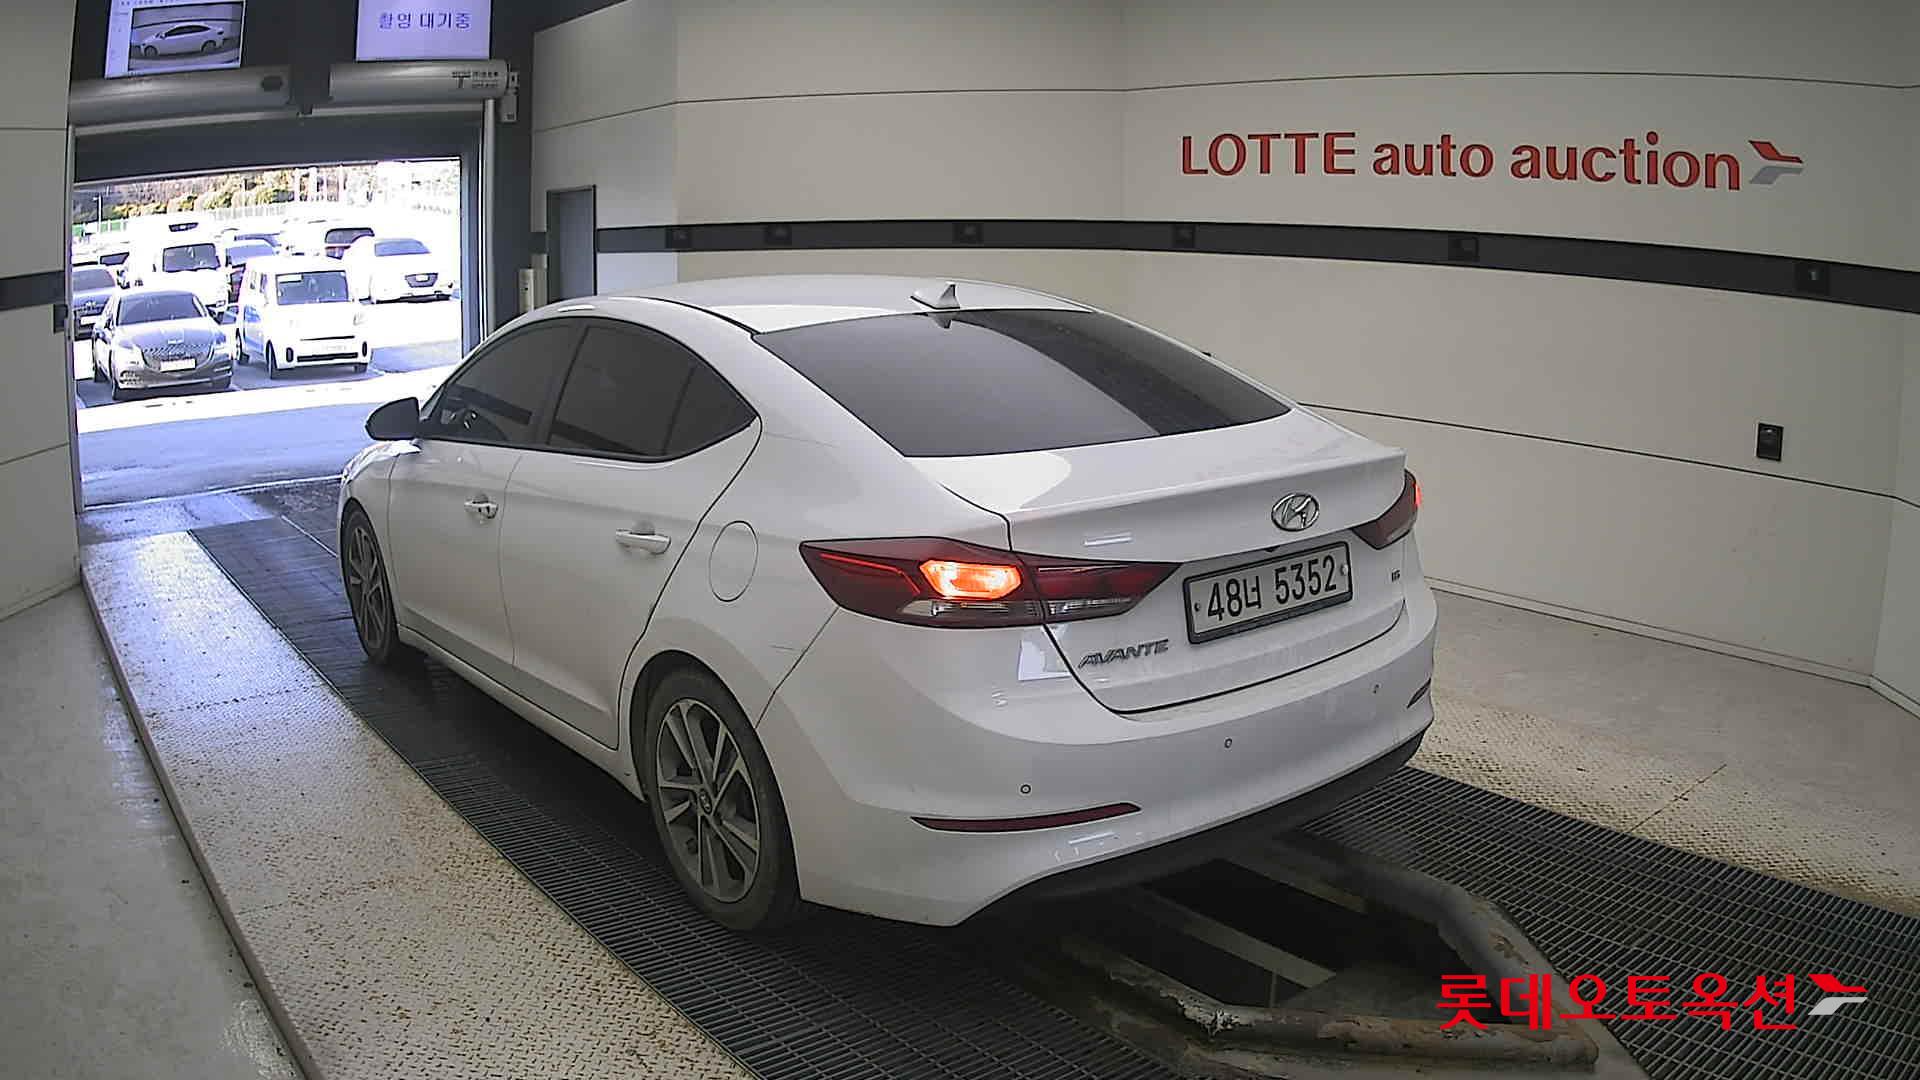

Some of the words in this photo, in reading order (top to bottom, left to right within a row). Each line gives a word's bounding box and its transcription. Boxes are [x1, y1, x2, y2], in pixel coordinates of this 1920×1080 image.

[419, 12, 470, 29] 대기중
[1182, 132, 1355, 176] LOTTE
[1374, 135, 1495, 179] auto
[1511, 132, 1741, 190] auction
[1207, 576, 1262, 621] 48너
[1275, 555, 1337, 604] 5352
[1079, 638, 1169, 668] AVANTE
